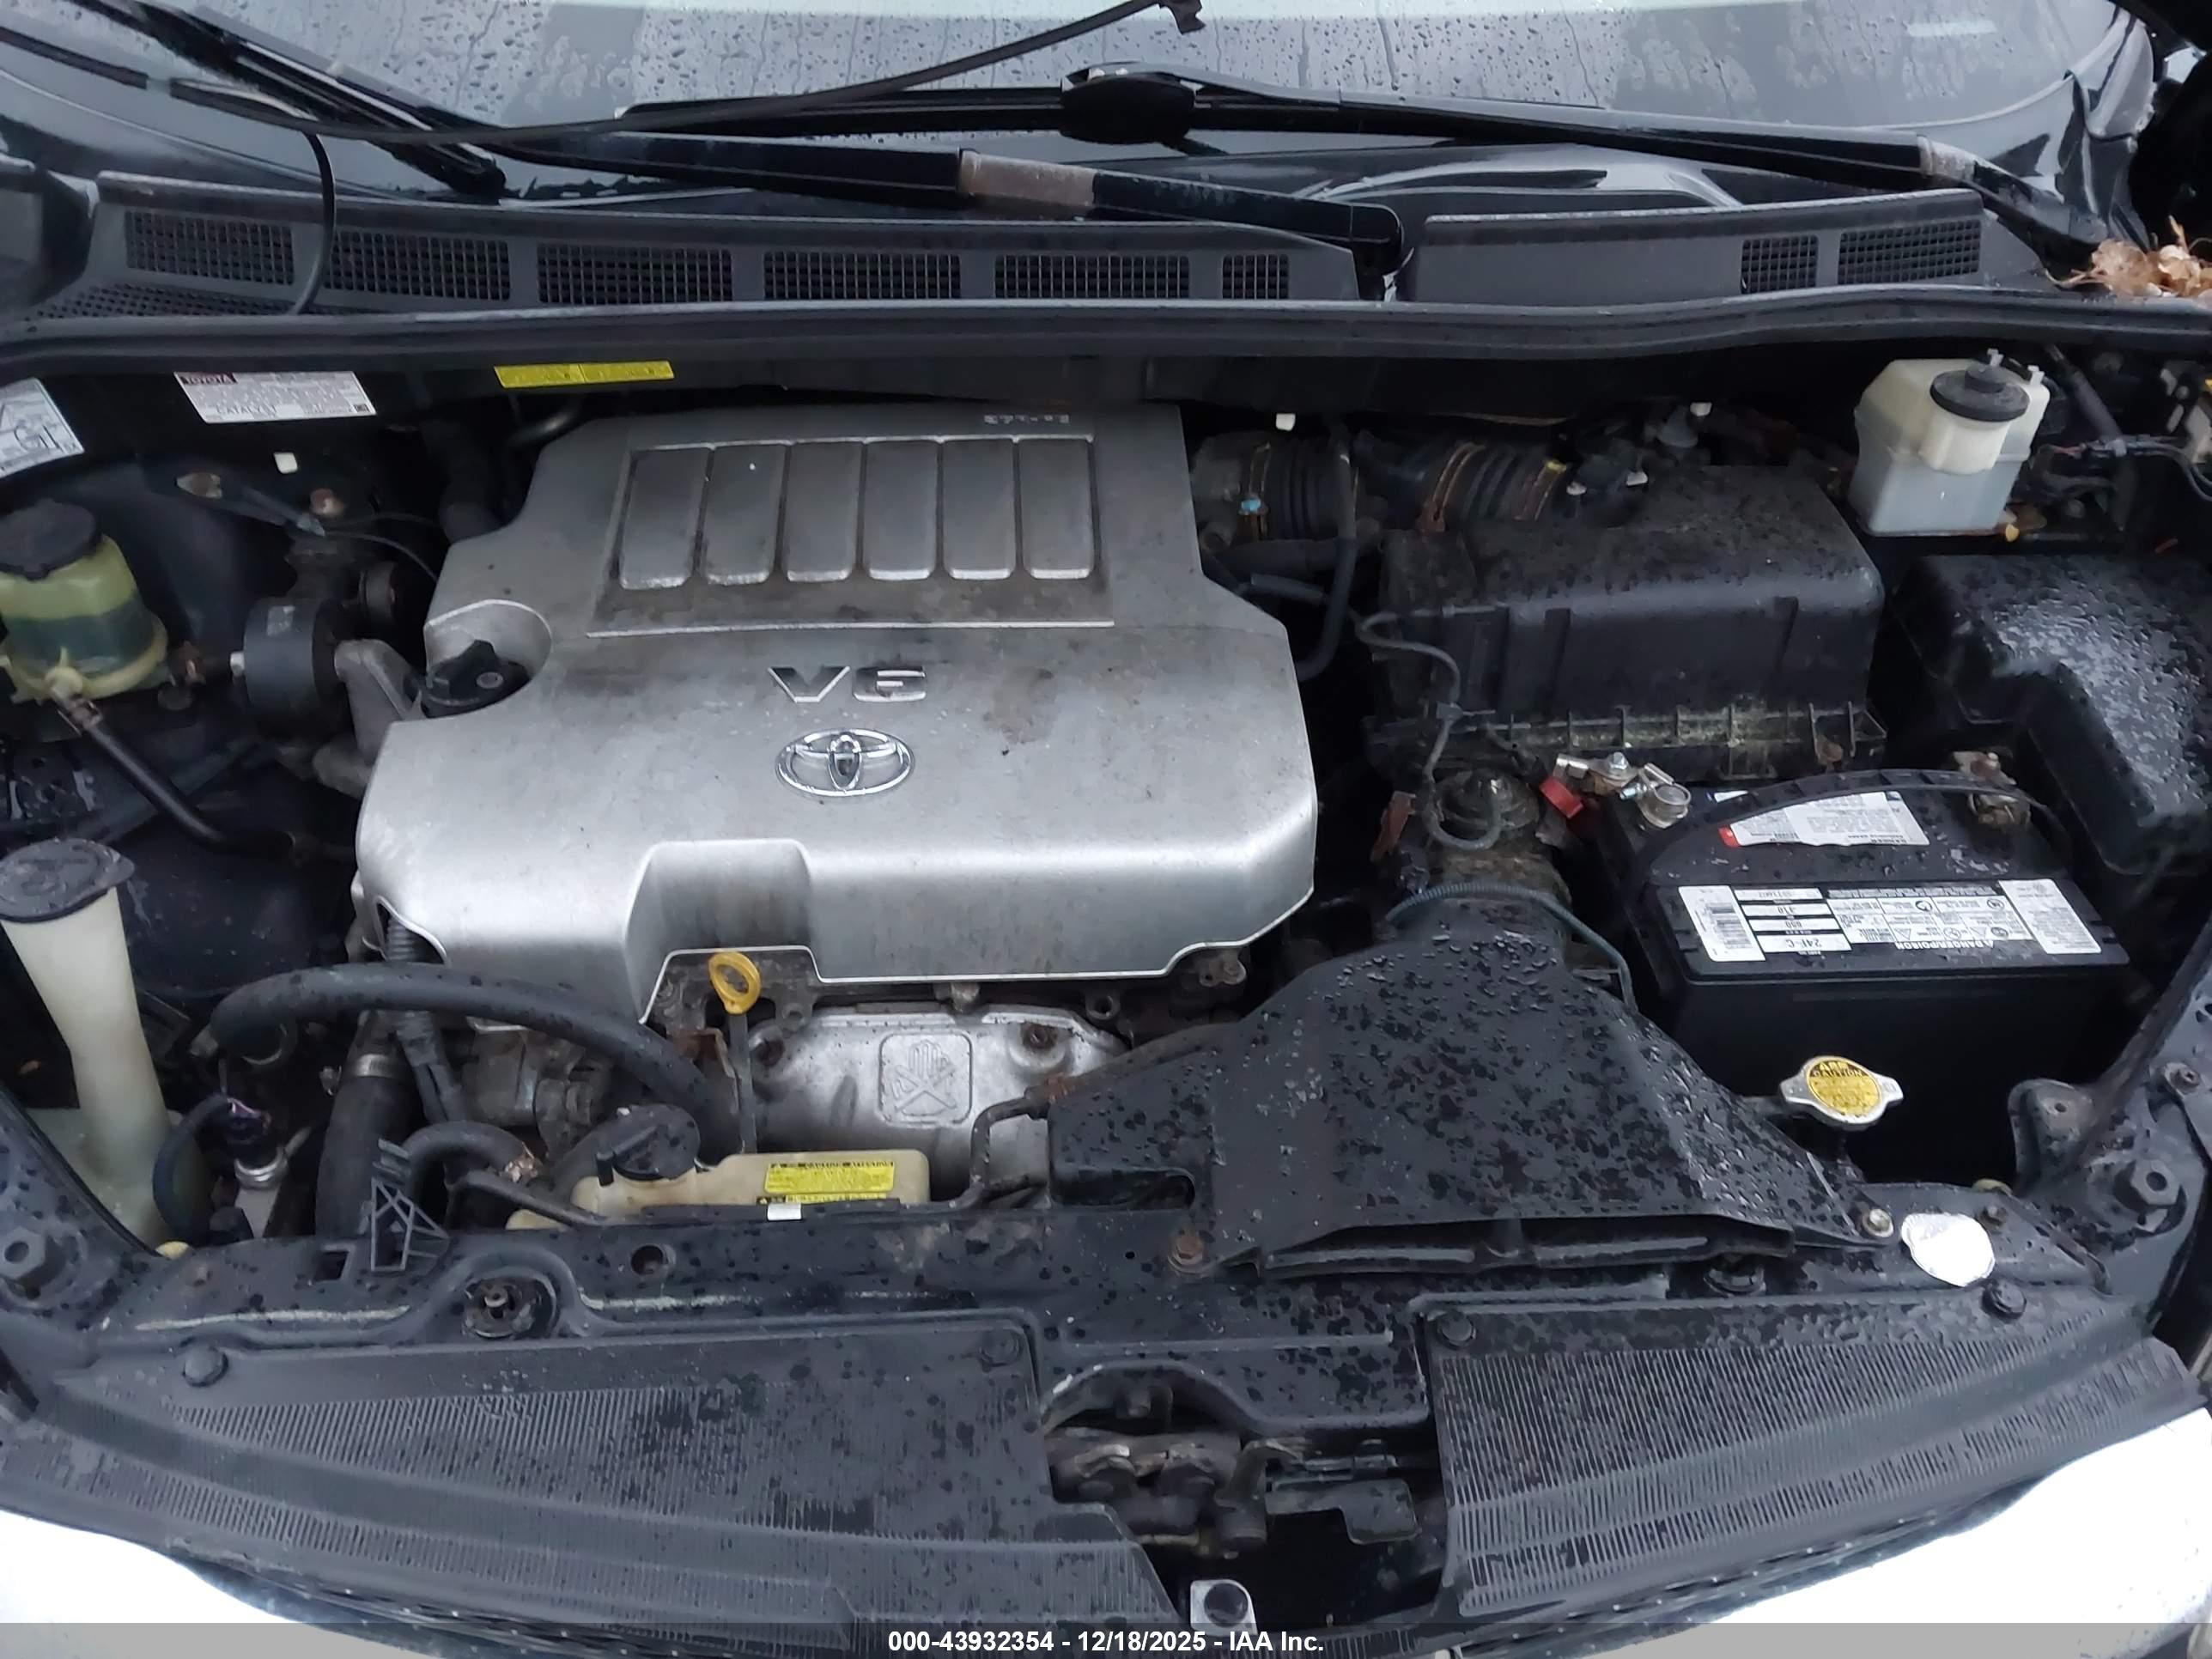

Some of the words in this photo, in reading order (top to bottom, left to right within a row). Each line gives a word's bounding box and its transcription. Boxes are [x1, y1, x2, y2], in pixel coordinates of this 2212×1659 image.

[181, 374, 237, 385] TOYOTA
[768, 665, 927, 704] V6
[1813, 1067, 1863, 1078] CAUTION
